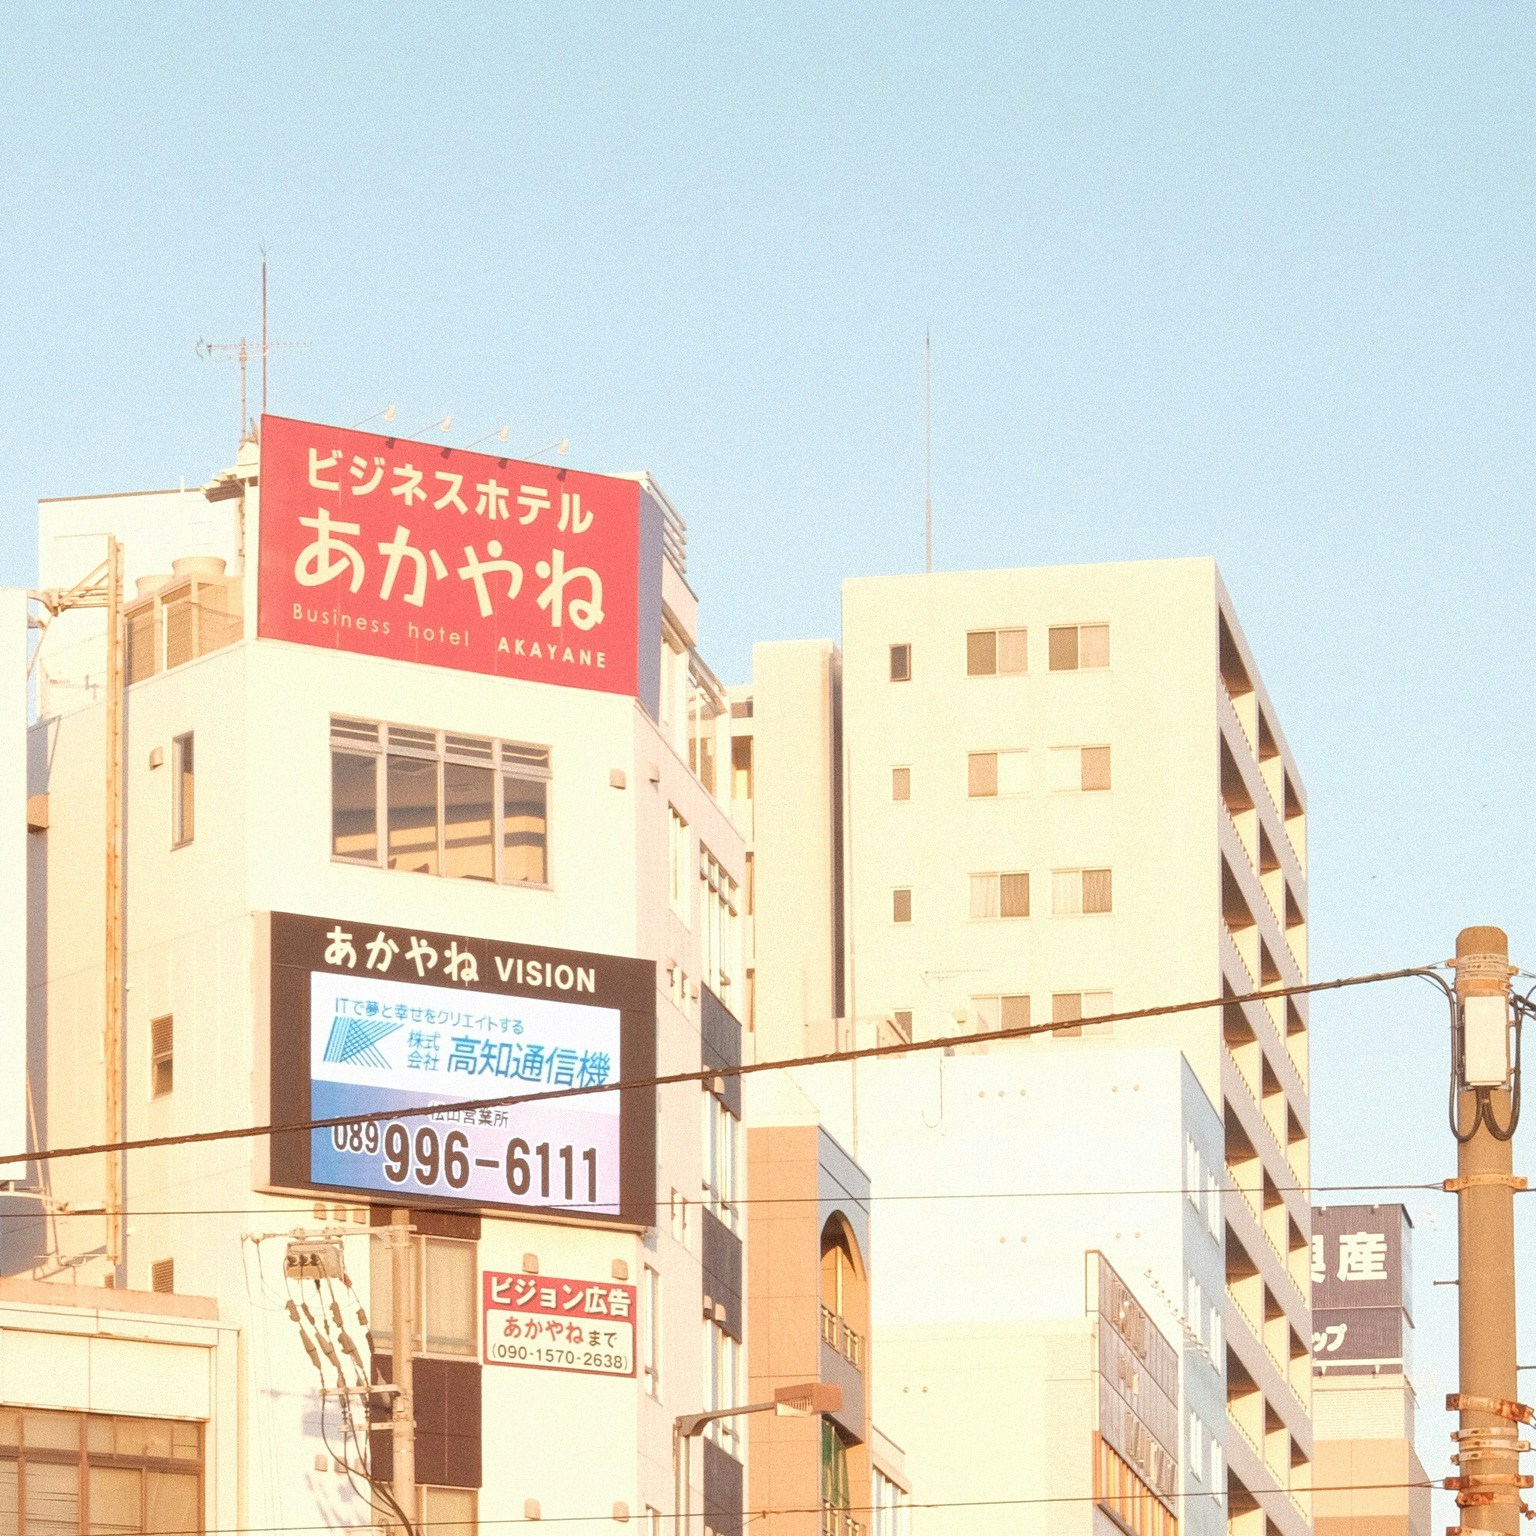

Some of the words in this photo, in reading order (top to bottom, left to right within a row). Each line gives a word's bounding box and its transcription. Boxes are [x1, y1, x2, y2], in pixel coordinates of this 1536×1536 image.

[308, 447, 595, 534] ビジネスホテル
[294, 507, 605, 631] あかやね
[293, 603, 392, 635] Business
[408, 621, 470, 648] hotel
[497, 636, 607, 669] AKAYANE
[324, 926, 480, 983] あかやね
[495, 956, 597, 993] VISION
[447, 1034, 611, 1088] 高知通信機
[384, 1123, 598, 1203] 996-6111
[491, 1276, 632, 1317] ビジョン広告
